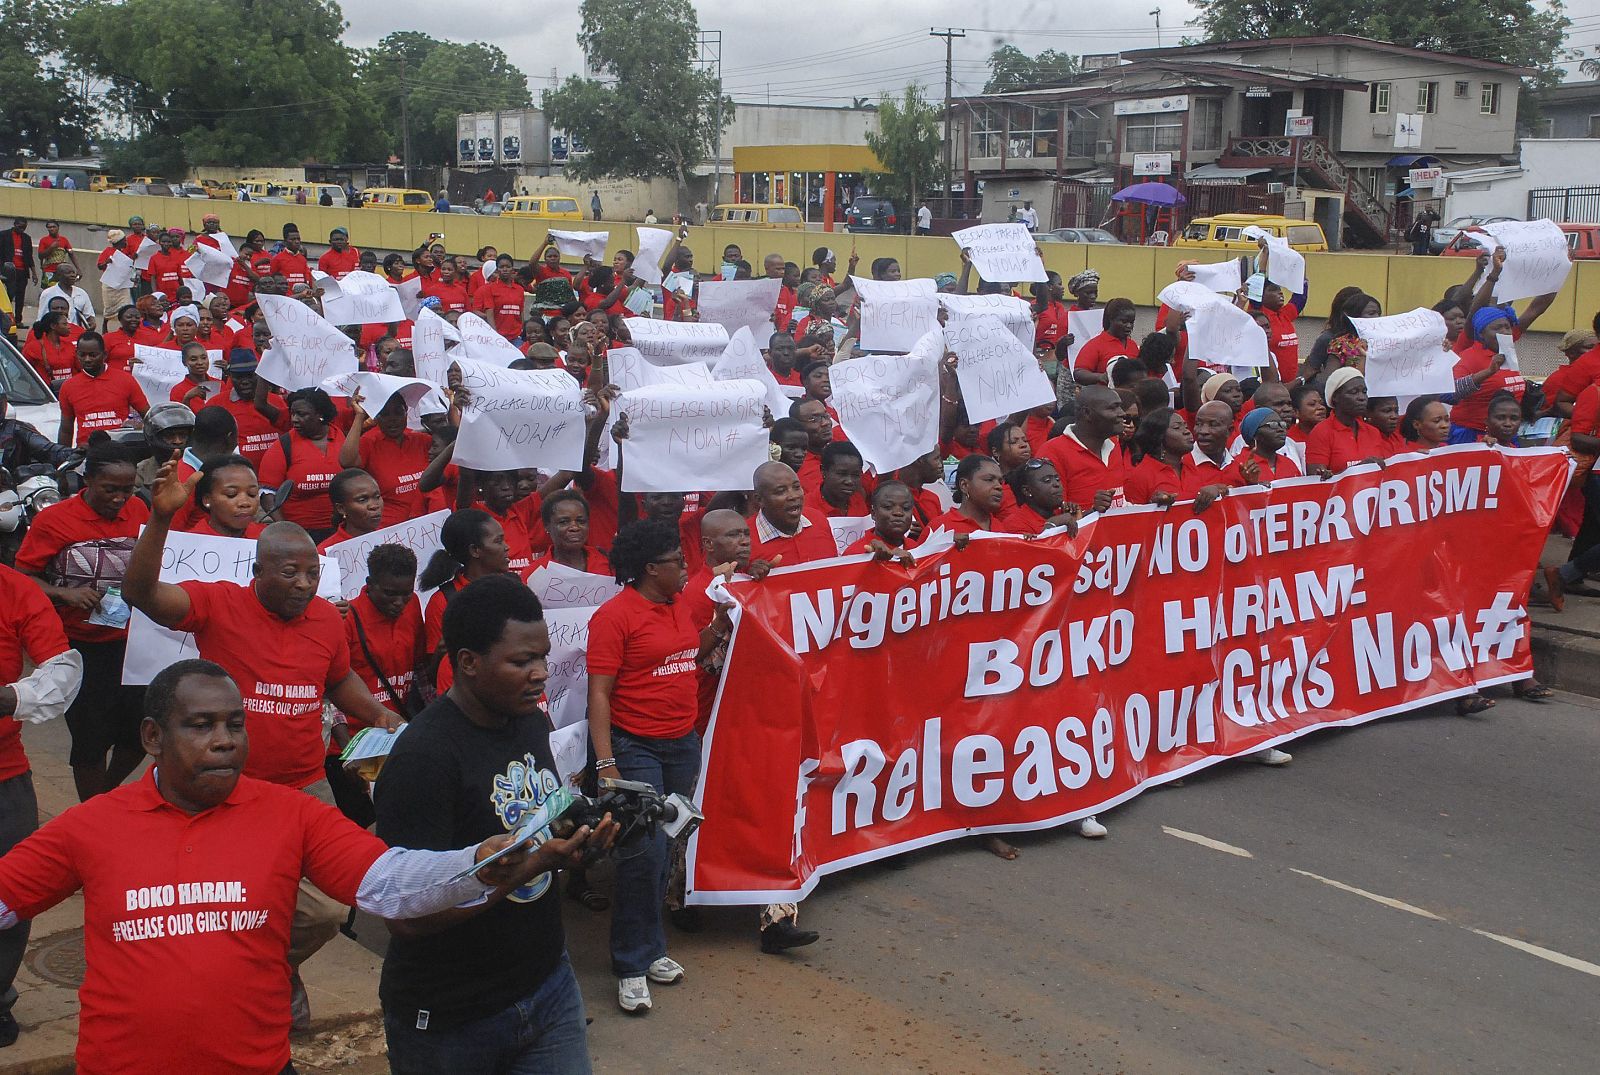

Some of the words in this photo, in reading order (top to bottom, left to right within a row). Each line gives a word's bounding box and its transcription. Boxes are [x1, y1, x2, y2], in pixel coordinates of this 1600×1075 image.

[1416, 171, 1439, 179] HELP
[987, 256, 1030, 275] NOW#
[832, 358, 887, 389] BOKO
[530, 397, 550, 411] OUR
[625, 397, 704, 424] #RELEASE
[710, 400, 732, 418] OUR
[496, 421, 567, 450] NOW#
[669, 425, 741, 457] NOW#
[298, 482, 320, 490] #RELEASE
[543, 577, 607, 605] BOKO
[790, 563, 1055, 653] Nigerians
[1073, 543, 1142, 596] say
[1147, 518, 1209, 578] NO
[964, 608, 1135, 698] BOKO
[1163, 564, 1367, 655] HARAM:
[256, 682, 284, 698] BOKO
[286, 684, 318, 698] HARAM:
[1124, 677, 1219, 764] our
[1222, 636, 1335, 728] Girls
[1351, 592, 1528, 695] Now#
[243, 698, 275, 714] #RELEASE
[276, 702, 292, 716] OUR
[126, 885, 174, 911] BOKO
[178, 882, 246, 905] HARAM:
[112, 915, 165, 942] #RELEASE
[167, 913, 194, 936] OUR
[196, 910, 228, 933] GIRLS
[230, 910, 268, 932] NOW#
